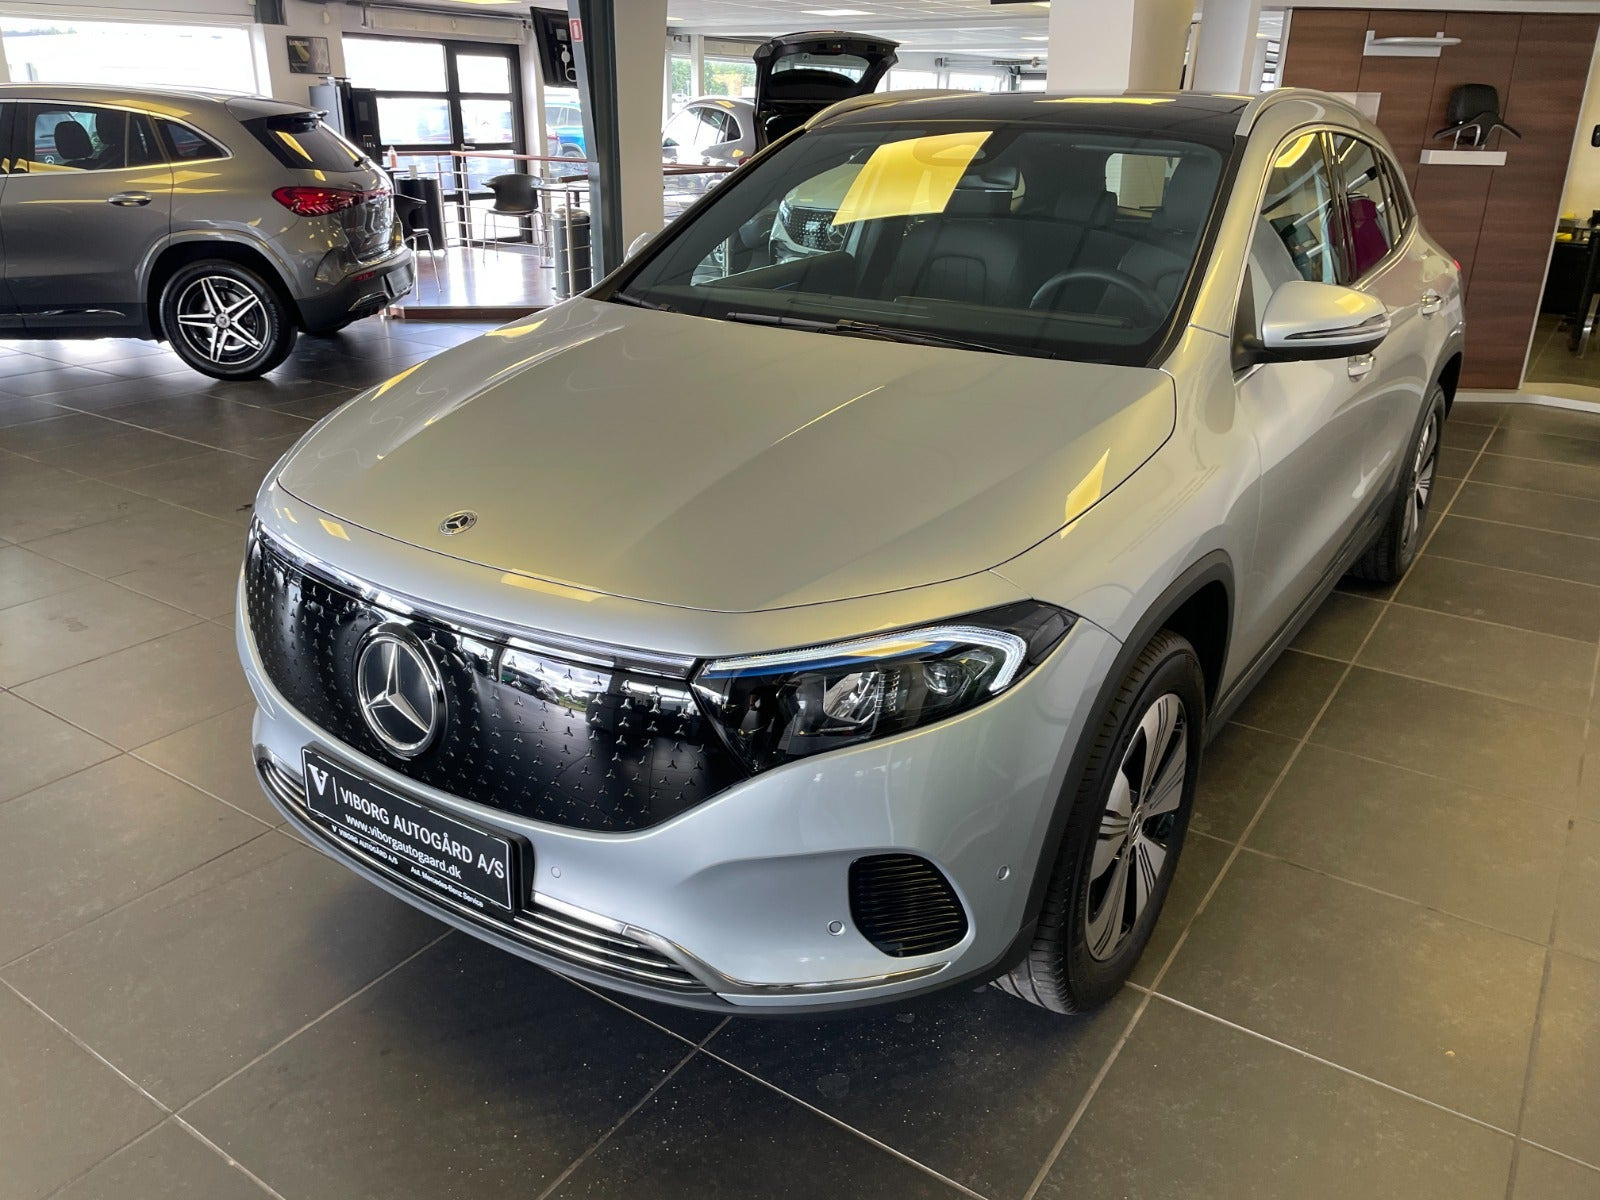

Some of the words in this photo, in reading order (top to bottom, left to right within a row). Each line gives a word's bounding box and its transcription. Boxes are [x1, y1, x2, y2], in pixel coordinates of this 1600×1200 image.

[340, 786, 390, 825] VIBORG
[393, 814, 473, 864] AUTOGÅRD
[477, 853, 505, 879] A/S
[345, 813, 462, 880] www.viborgautogaard.dk
